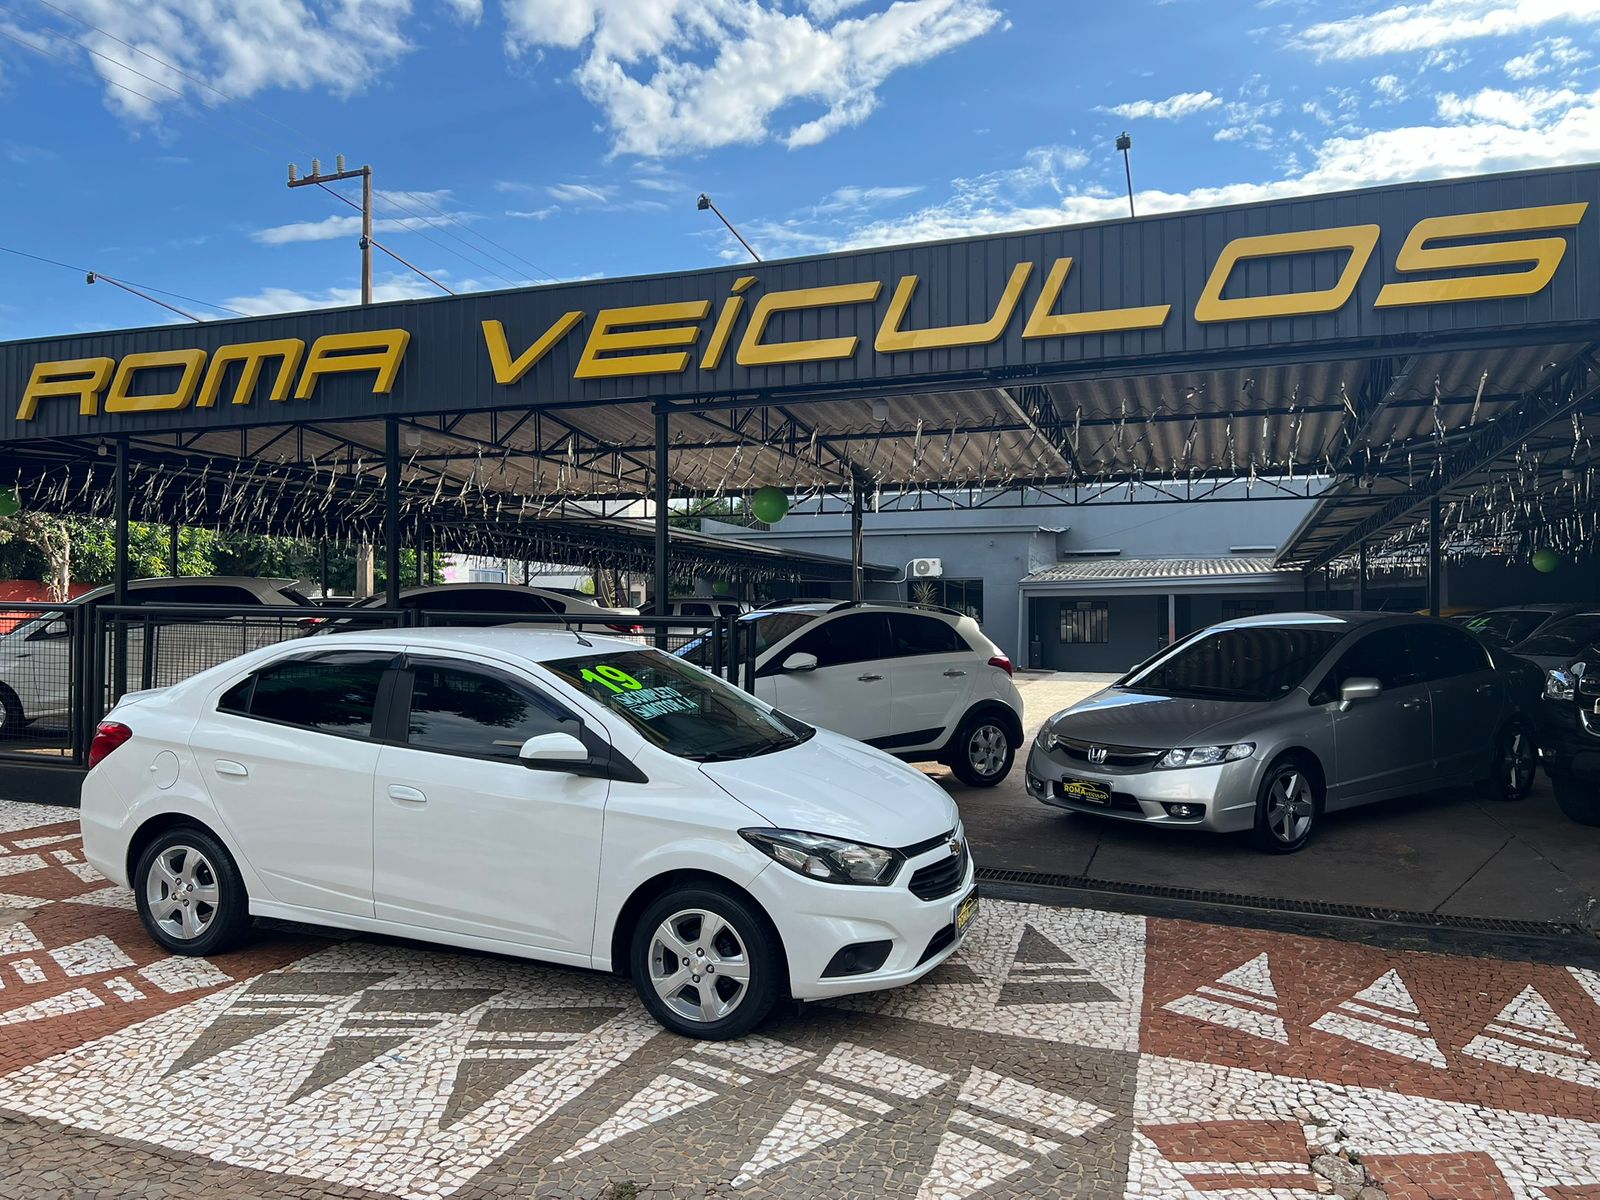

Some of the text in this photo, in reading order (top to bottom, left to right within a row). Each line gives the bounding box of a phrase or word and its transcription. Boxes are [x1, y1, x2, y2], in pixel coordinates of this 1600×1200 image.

[16, 202, 1588, 420] ROMA VEÍCULOS
[580, 665, 642, 694] 19
[1064, 784, 1085, 795] ROMA
